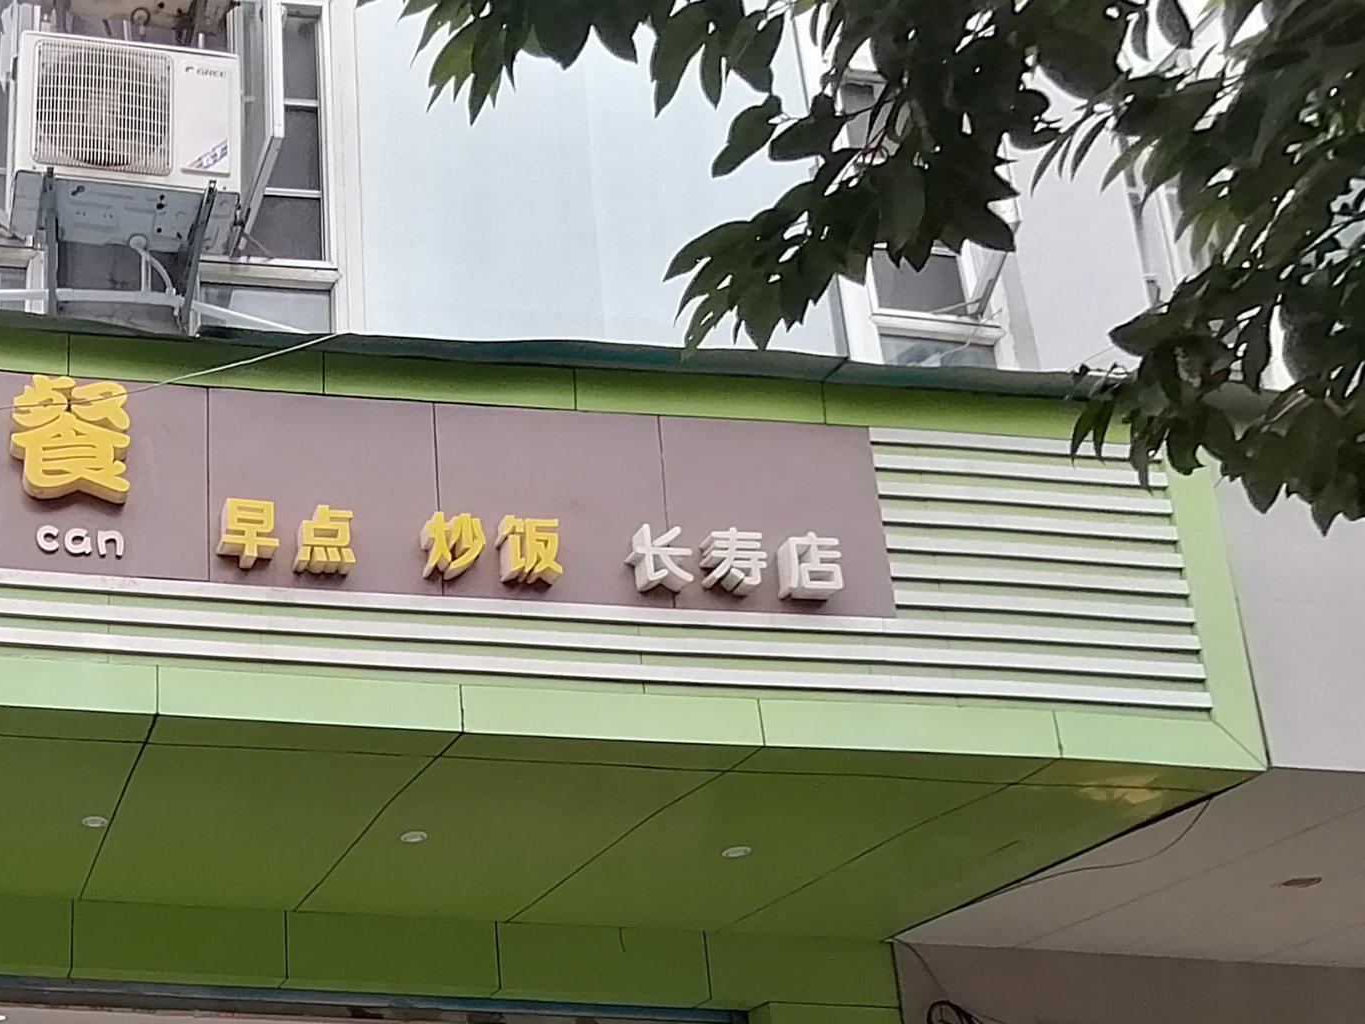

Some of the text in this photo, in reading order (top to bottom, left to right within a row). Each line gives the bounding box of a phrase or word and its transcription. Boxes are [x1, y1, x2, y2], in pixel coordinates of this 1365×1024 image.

[36, 522, 126, 558] can
[218, 497, 846, 600] 早点 炒饭 长寿店
